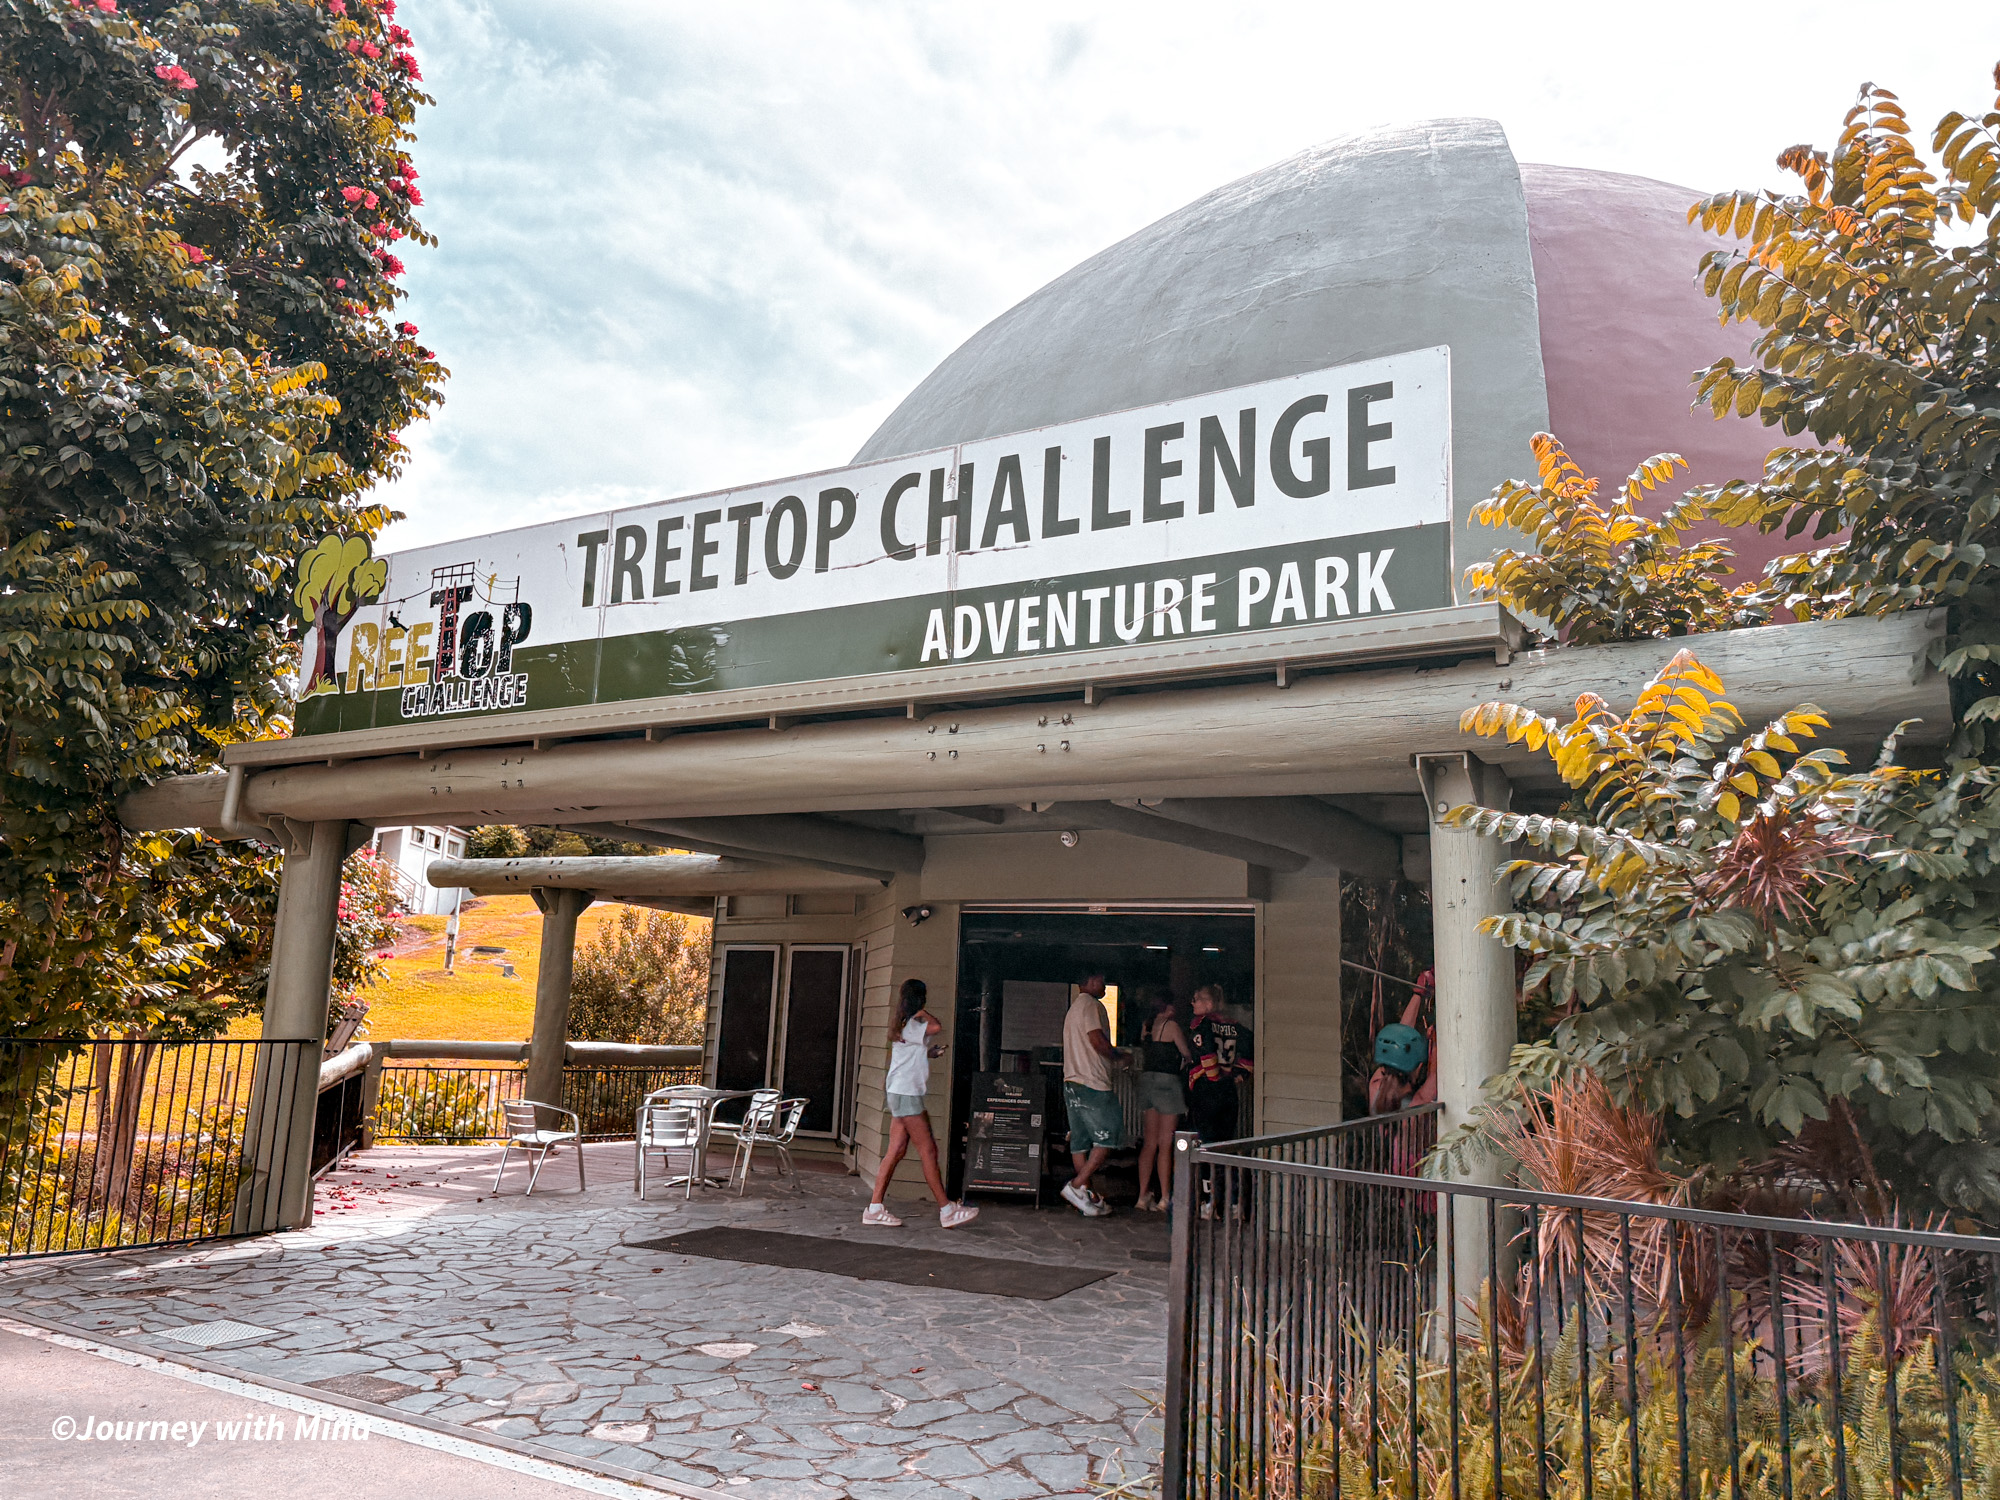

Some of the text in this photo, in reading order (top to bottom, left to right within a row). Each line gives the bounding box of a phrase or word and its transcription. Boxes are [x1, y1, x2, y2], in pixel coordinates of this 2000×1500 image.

[577, 380, 1396, 607] TREETOP CHALLENGE
[920, 548, 1396, 663] ADVENTURE PARK
[400, 673, 529, 718] CHALLENGE
